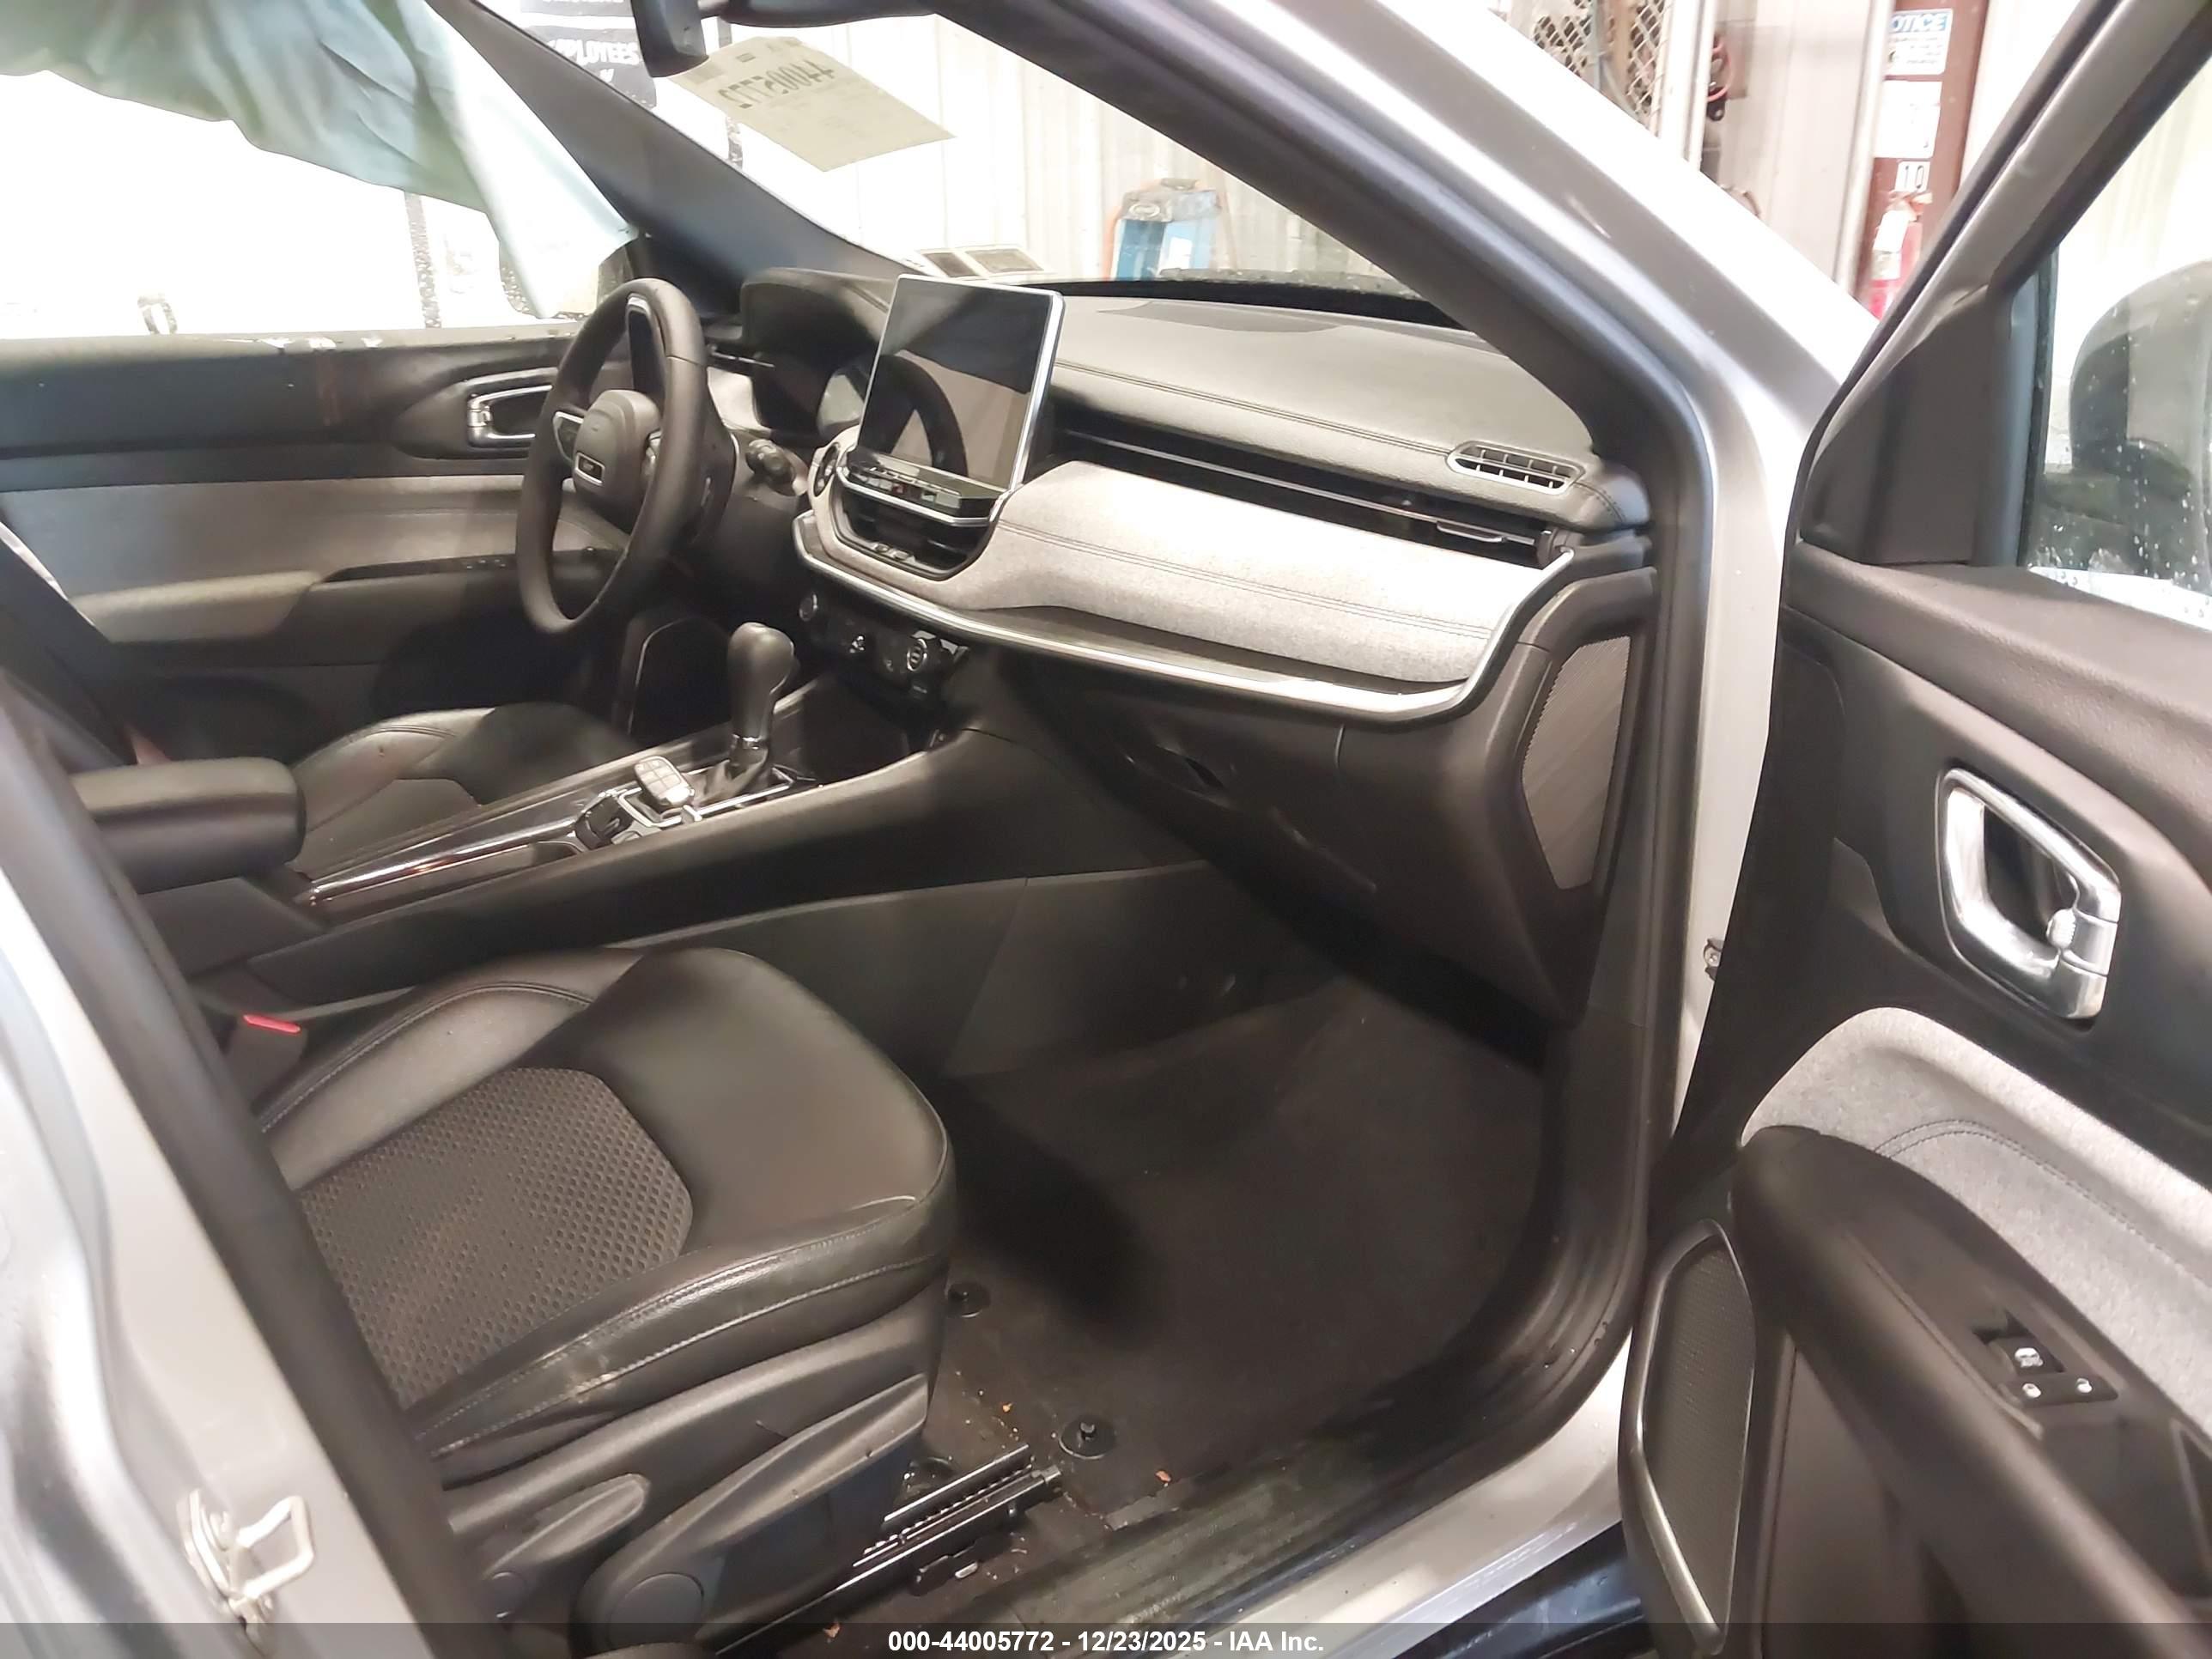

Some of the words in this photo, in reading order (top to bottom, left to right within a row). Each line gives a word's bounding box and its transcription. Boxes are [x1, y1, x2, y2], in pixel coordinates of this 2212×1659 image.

[1891, 14, 1948, 33] OTICE
[546, 39, 641, 66] MPLOYEES
[1905, 165, 1924, 189] 10
